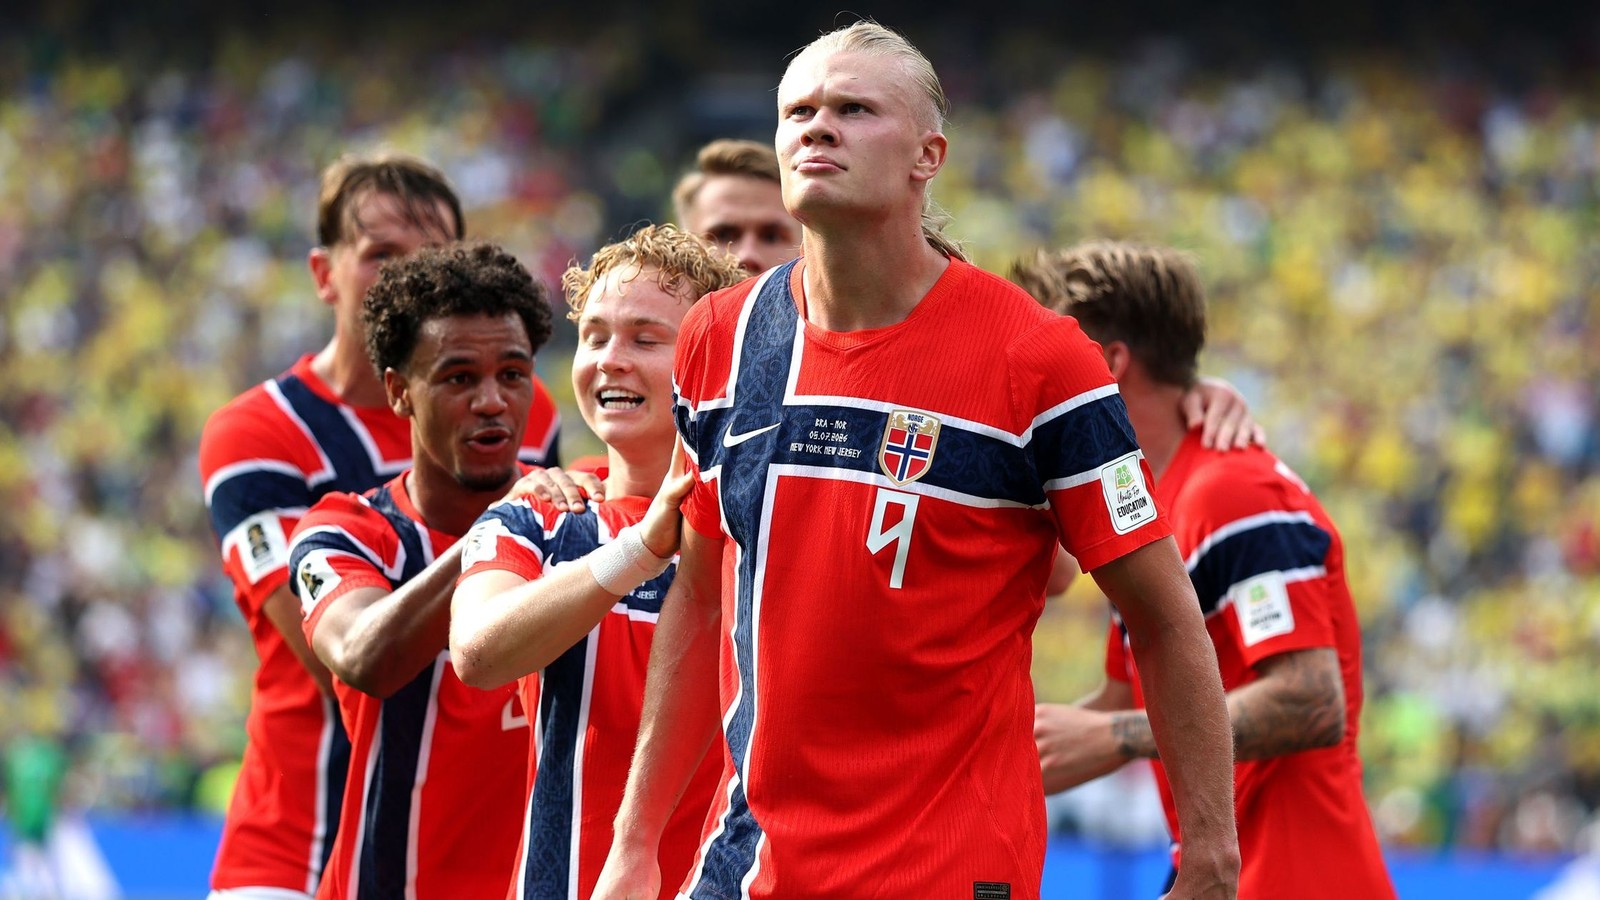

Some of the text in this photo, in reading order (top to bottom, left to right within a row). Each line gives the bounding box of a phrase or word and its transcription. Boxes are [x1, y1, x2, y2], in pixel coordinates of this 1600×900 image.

[815, 418, 828, 428] BRA
[834, 420, 847, 429] NOR
[908, 413, 924, 423] NORGE
[809, 431, 848, 442] 05.07.2026
[790, 442, 862, 458] NEW YORK NEW JERSEY
[1117, 496, 1147, 517] EDUCATION
[1130, 512, 1141, 521] FIFA
[866, 487, 920, 589] 9
[636, 590, 658, 600] JERSEY
